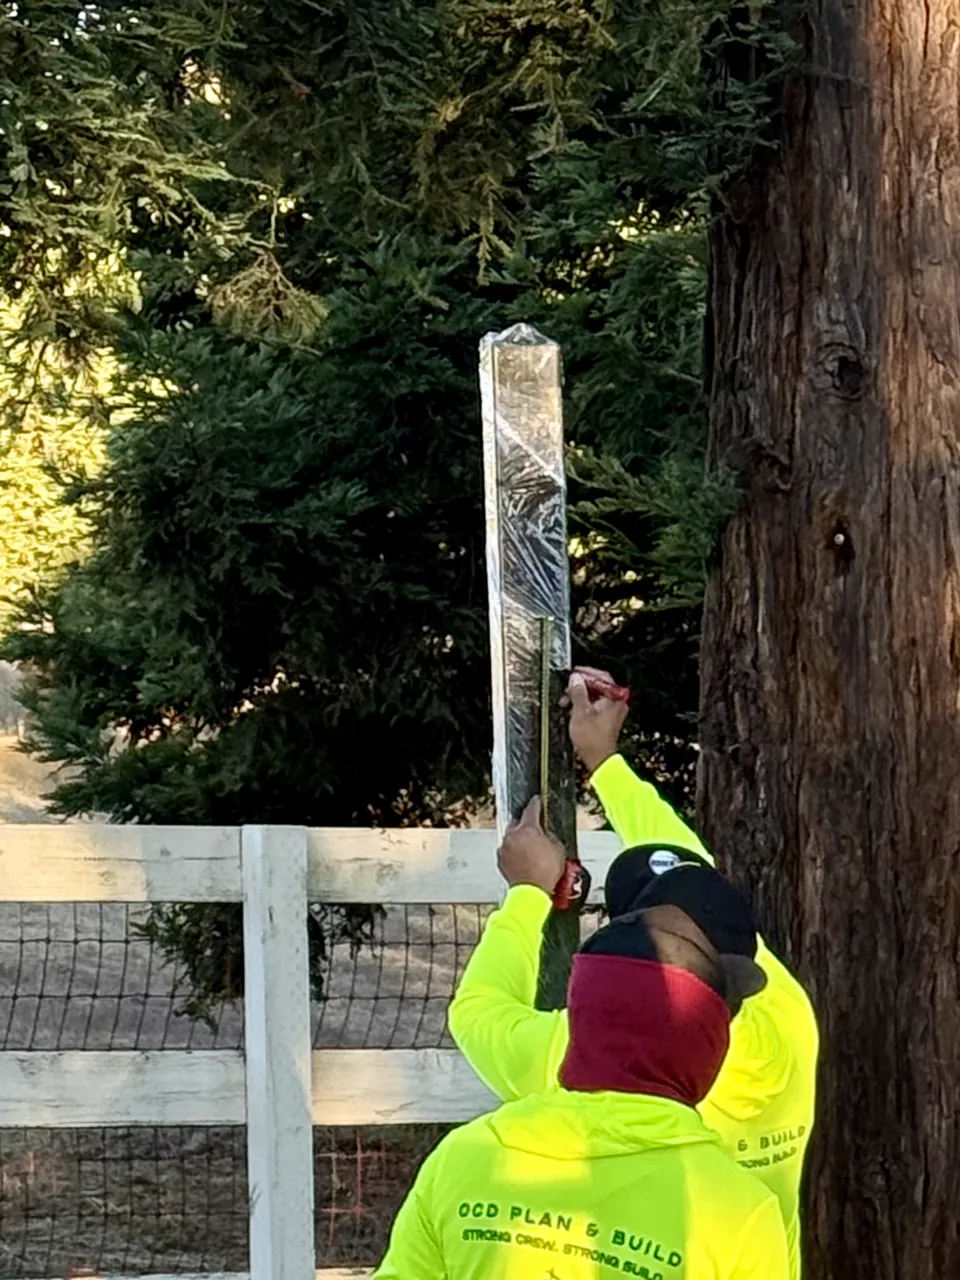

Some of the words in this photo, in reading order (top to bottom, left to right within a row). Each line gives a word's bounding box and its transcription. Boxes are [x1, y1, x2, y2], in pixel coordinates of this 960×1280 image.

[759, 1125, 806, 1150] BUILD
[458, 1202, 499, 1218] OCD
[509, 1206, 573, 1232] PLAN
[585, 1223, 600, 1237] &
[611, 1229, 682, 1268] BUILD
[462, 1228, 512, 1243] STRONG
[562, 1243, 619, 1269] STRONG
